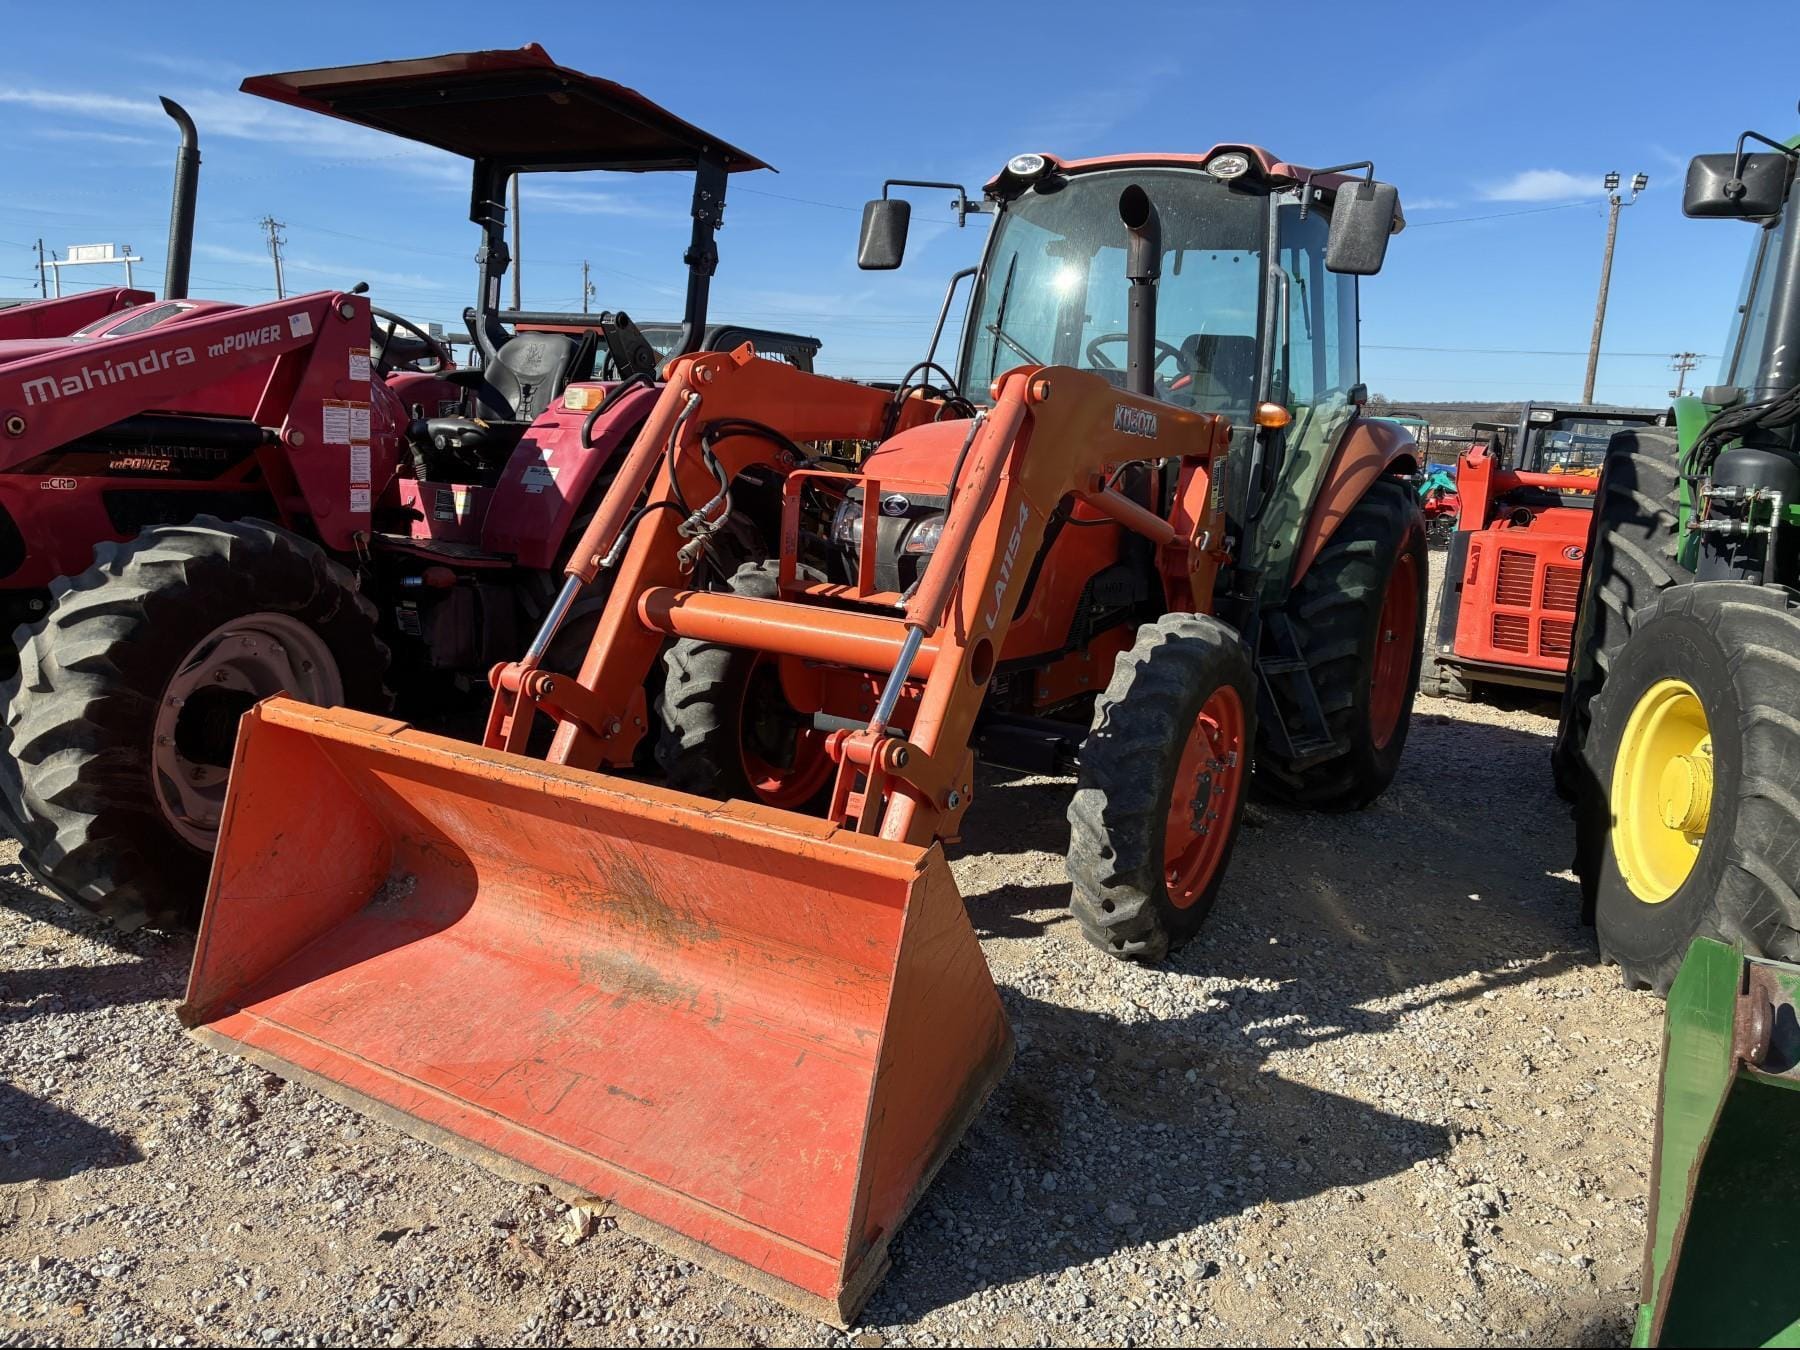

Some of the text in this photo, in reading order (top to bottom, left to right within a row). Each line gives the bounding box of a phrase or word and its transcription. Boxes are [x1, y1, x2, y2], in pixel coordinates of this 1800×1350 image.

[22, 325, 281, 406] Mahindra mPOWER
[1113, 403, 1157, 439] KUBOTA
[109, 457, 171, 472] mPOWER
[41, 478, 77, 490] mCRD
[985, 501, 1029, 630] LA1154
